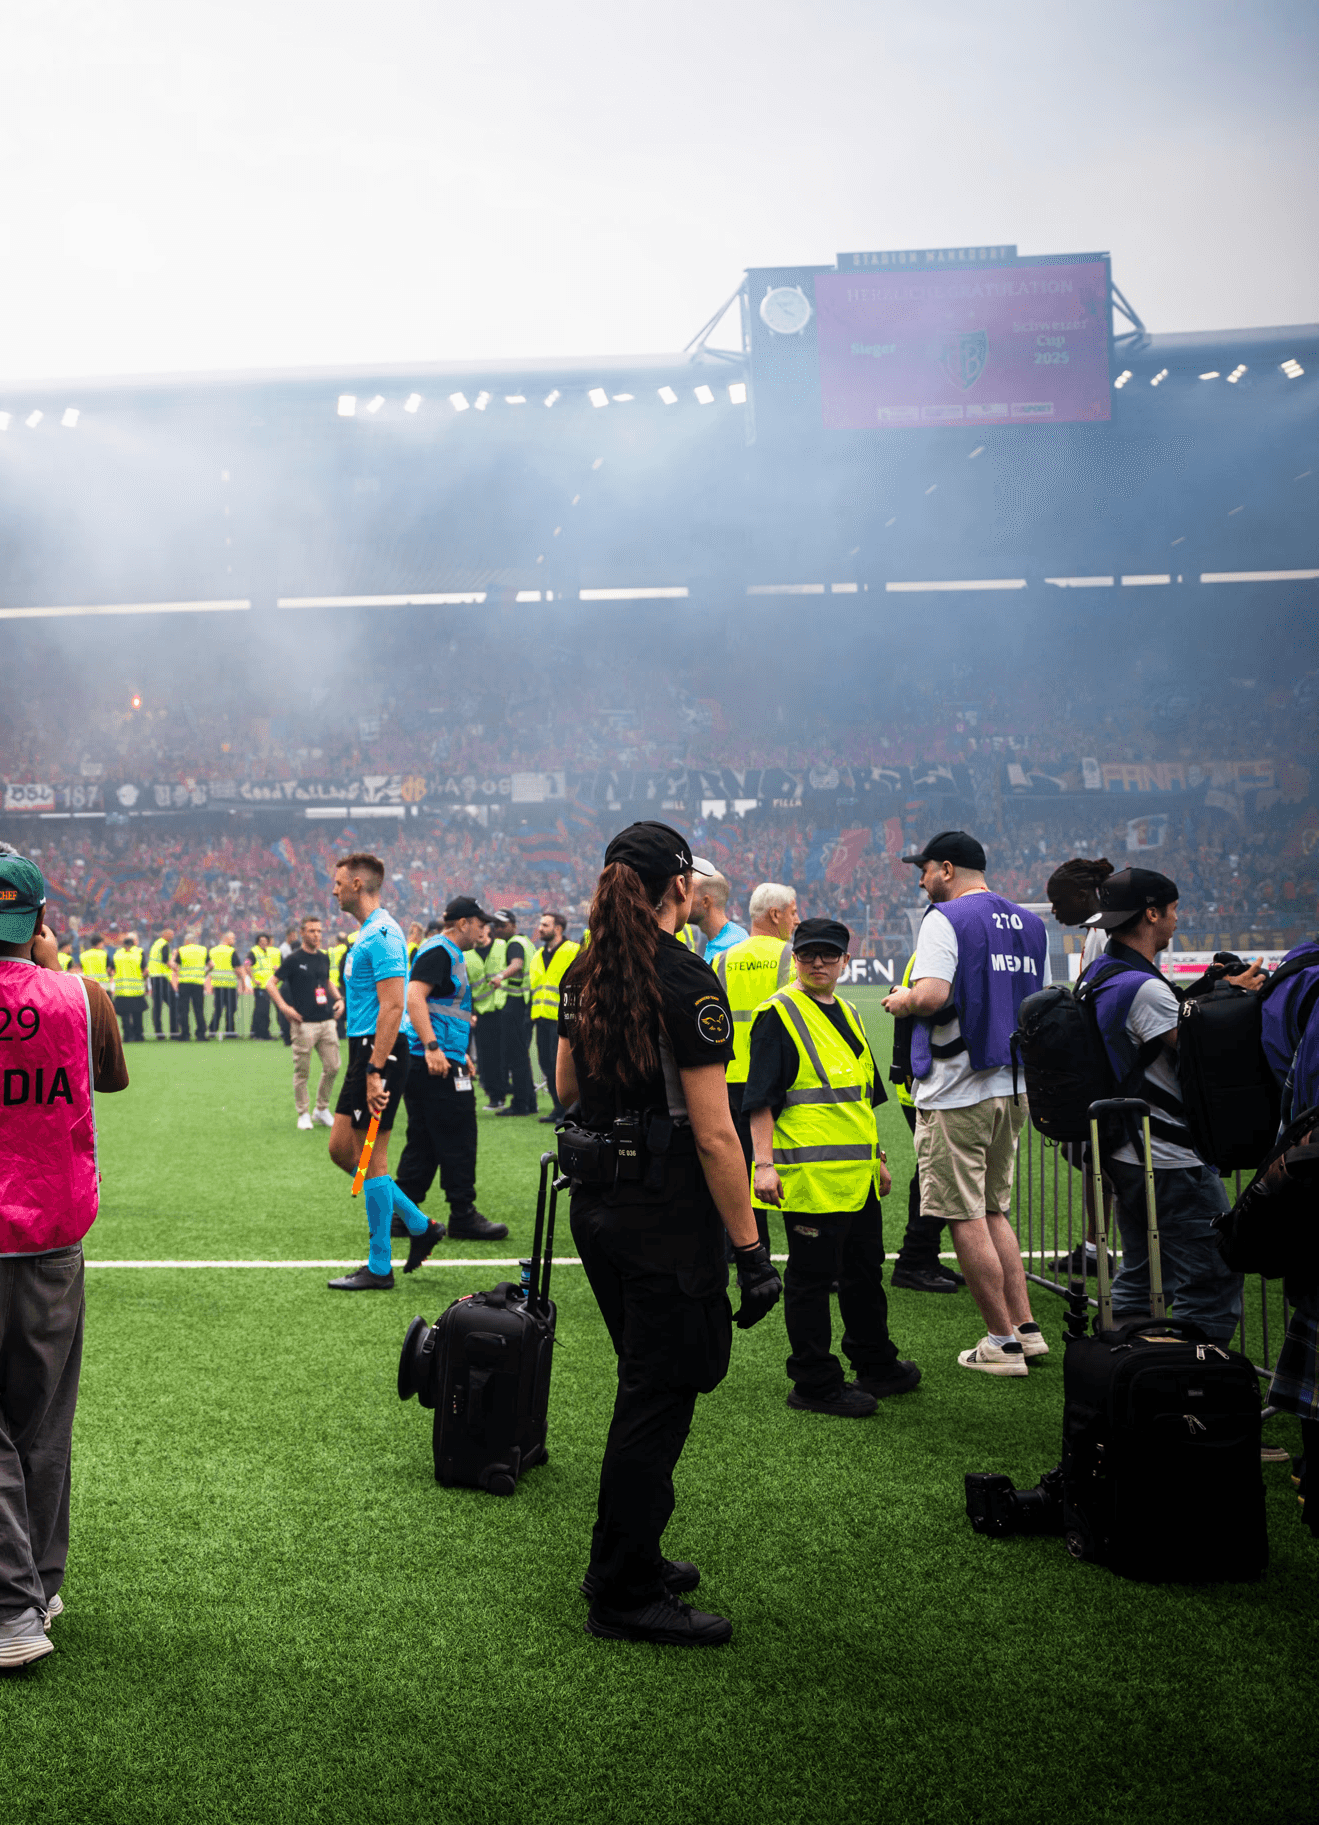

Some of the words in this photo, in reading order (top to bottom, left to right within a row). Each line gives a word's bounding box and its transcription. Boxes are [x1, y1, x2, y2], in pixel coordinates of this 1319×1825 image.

[1037, 335, 1065, 348] Cup
[1034, 351, 1070, 365] 2025
[726, 959, 778, 972] STEWARD
